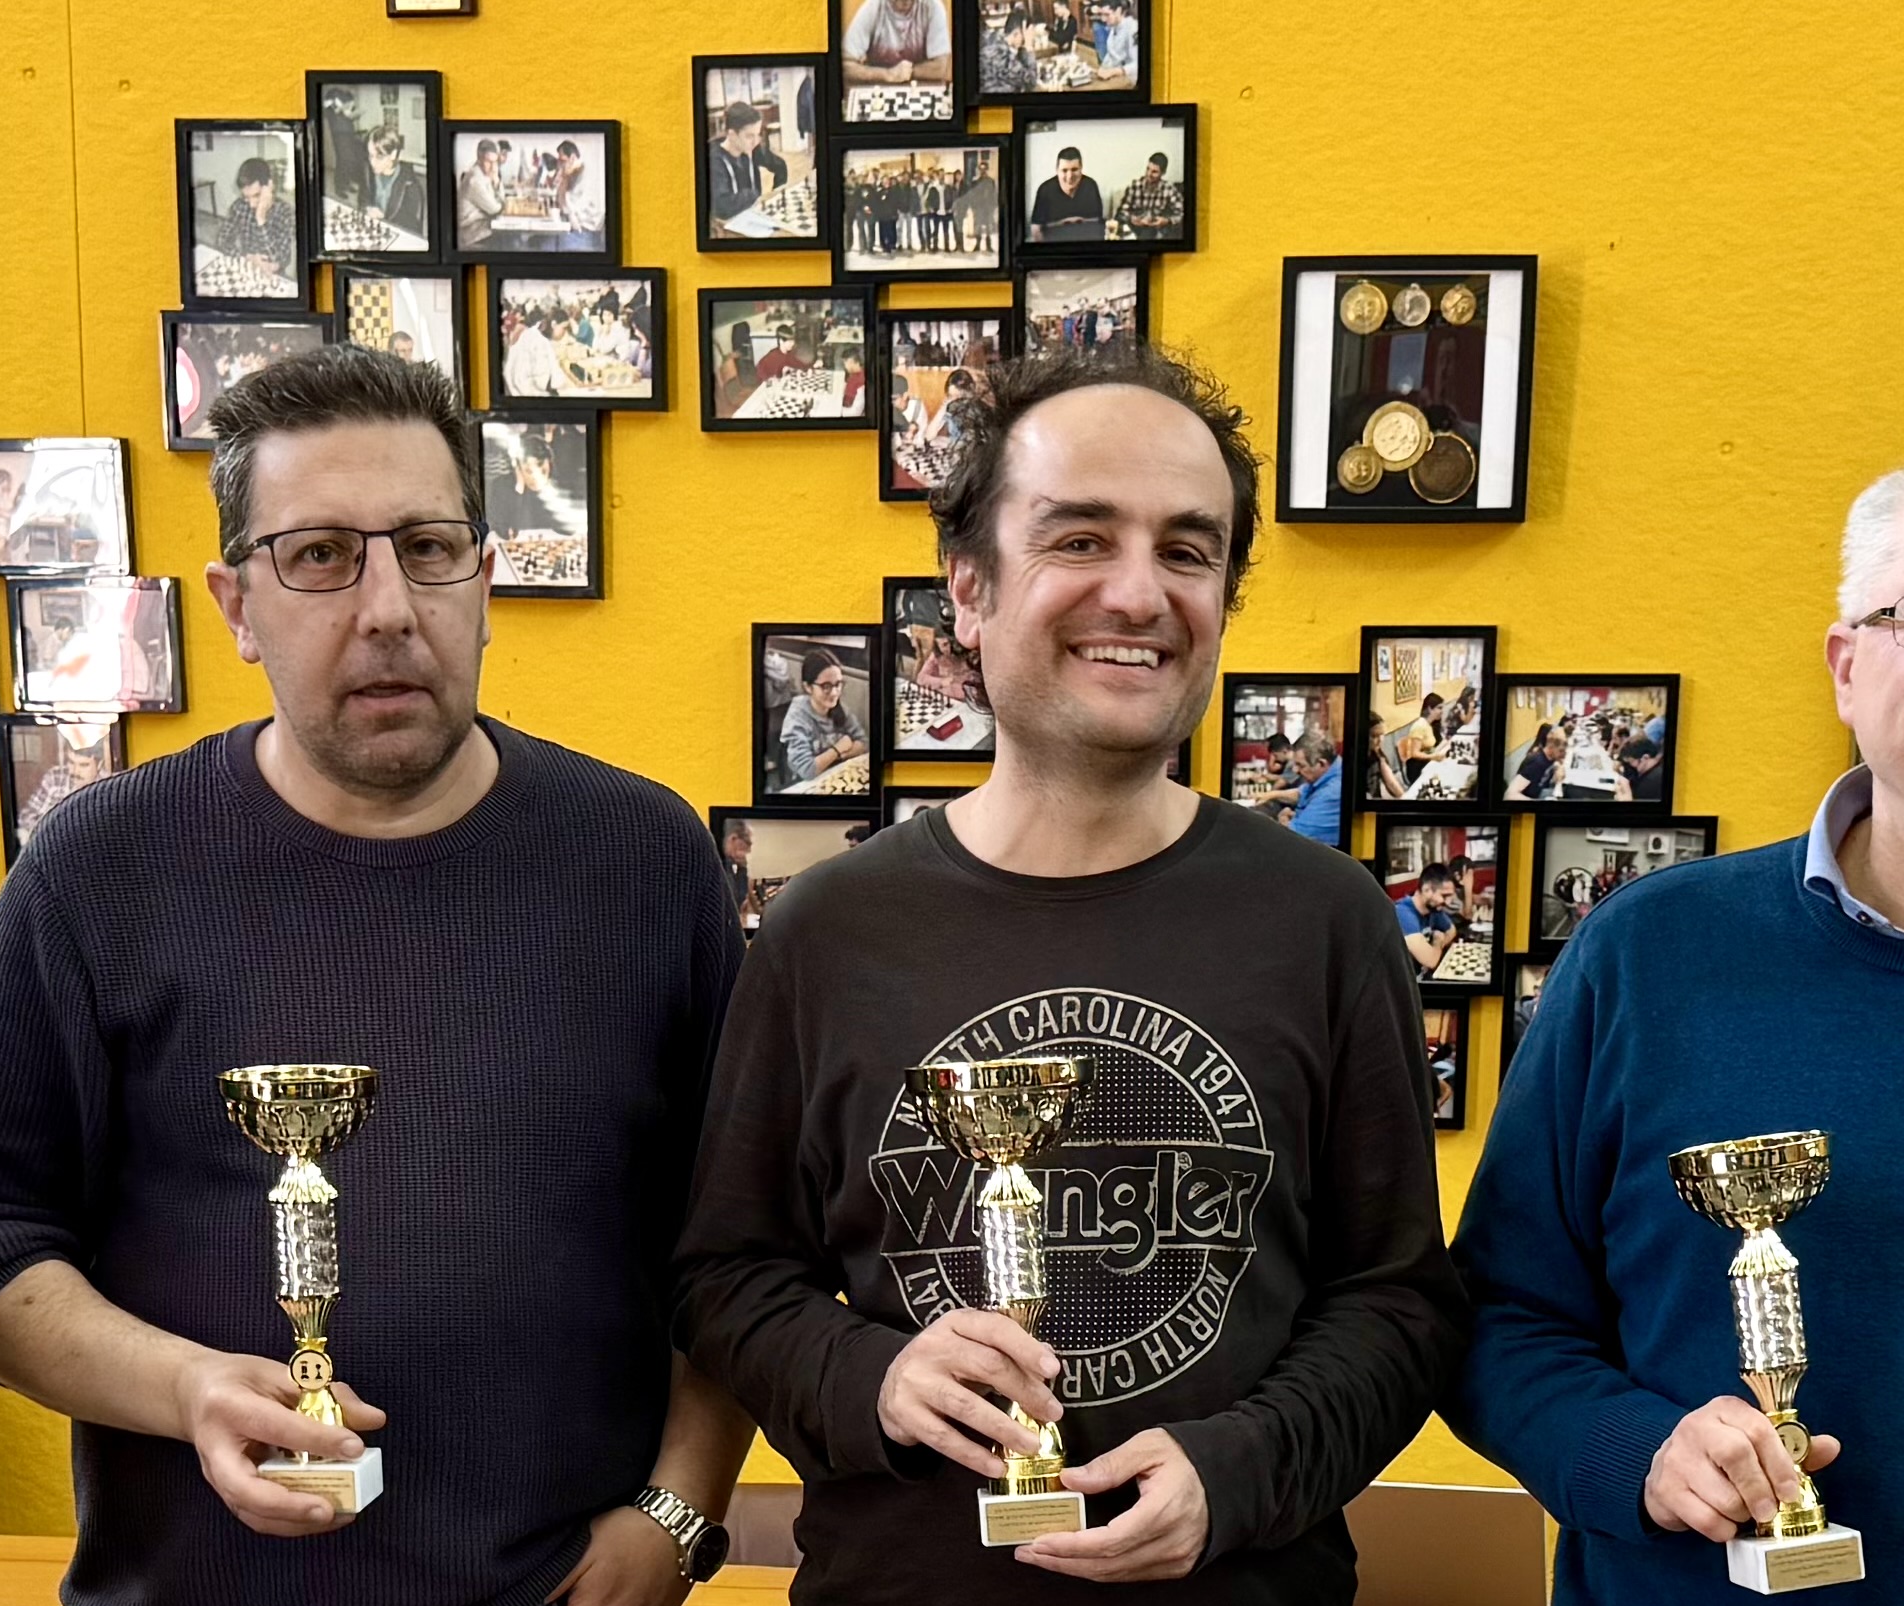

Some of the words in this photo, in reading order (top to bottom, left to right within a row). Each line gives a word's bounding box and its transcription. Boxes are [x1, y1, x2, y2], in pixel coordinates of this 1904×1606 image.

[895, 1020, 1004, 1133] NTH
[1008, 995, 1194, 1066] CAROLINA
[1188, 1050, 1257, 1131] 1947
[879, 1150, 1260, 1274] Wngler
[1140, 1262, 1230, 1375] NORTH
